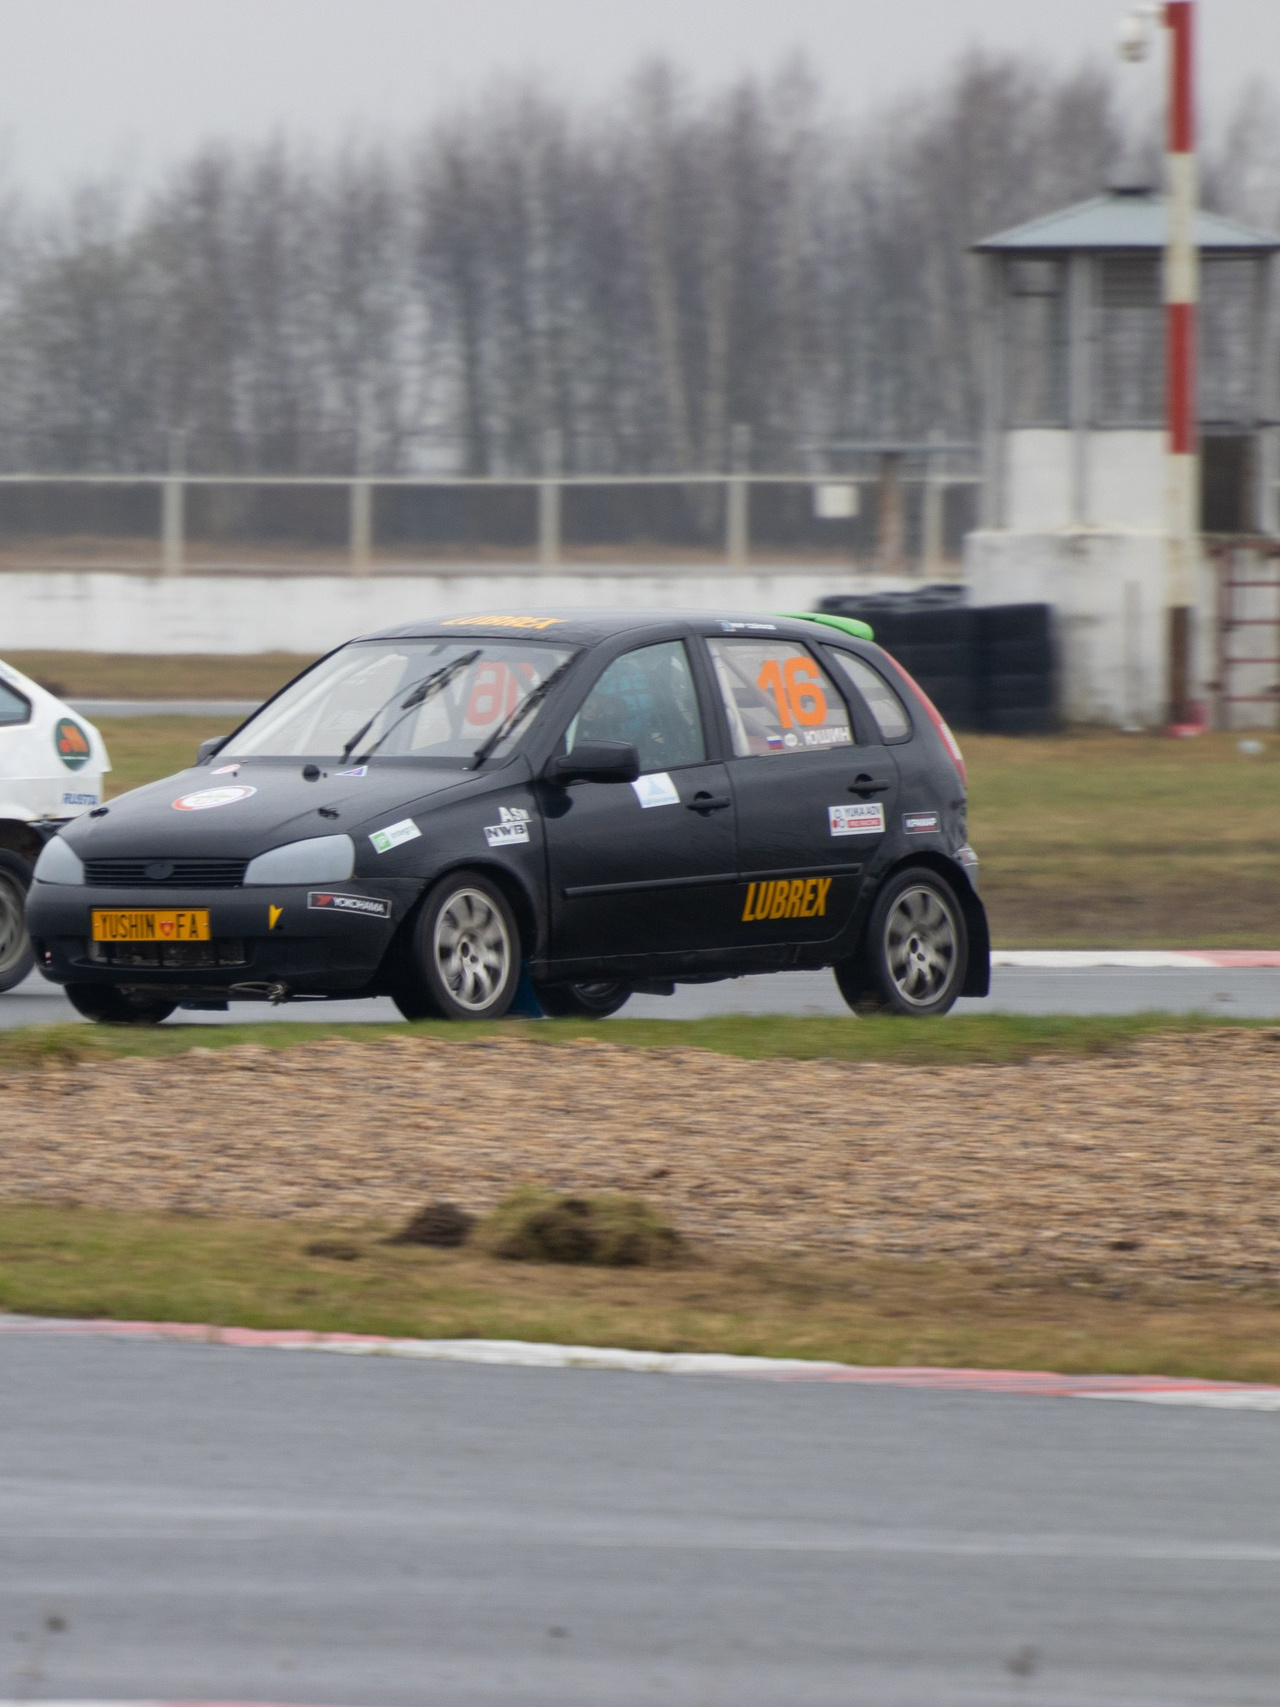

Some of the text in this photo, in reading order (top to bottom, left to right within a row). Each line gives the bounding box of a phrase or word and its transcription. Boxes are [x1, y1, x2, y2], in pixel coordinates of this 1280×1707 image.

[756, 656, 827, 729] 16
[803, 726, 850, 746] ЮШИН
[485, 824, 526, 838] NWB
[332, 896, 384, 914] YOKOHAMA
[741, 877, 832, 922] LUBREX
[100, 914, 155, 939] YUSHIN
